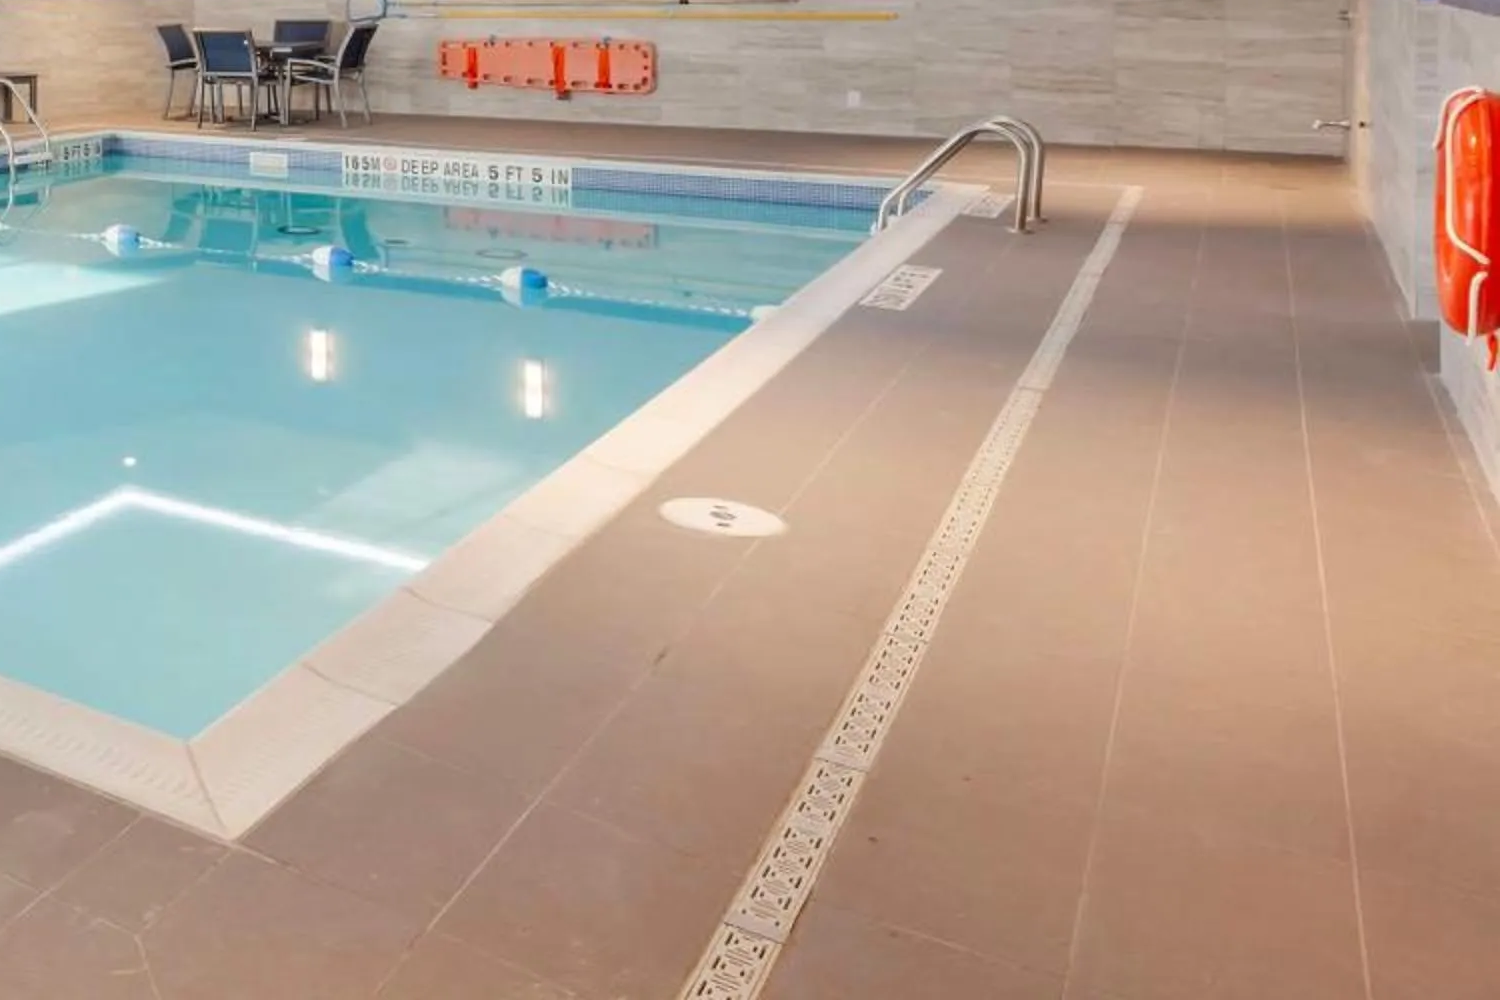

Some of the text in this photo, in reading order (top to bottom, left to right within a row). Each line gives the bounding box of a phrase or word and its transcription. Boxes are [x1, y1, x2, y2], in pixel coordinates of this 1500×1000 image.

[401, 159, 439, 175] DEEP
[443, 161, 479, 179] AREA
[488, 165, 499, 181] 5
[505, 165, 523, 182] FT
[531, 167, 543, 183] 5
[551, 168, 569, 185] IN
